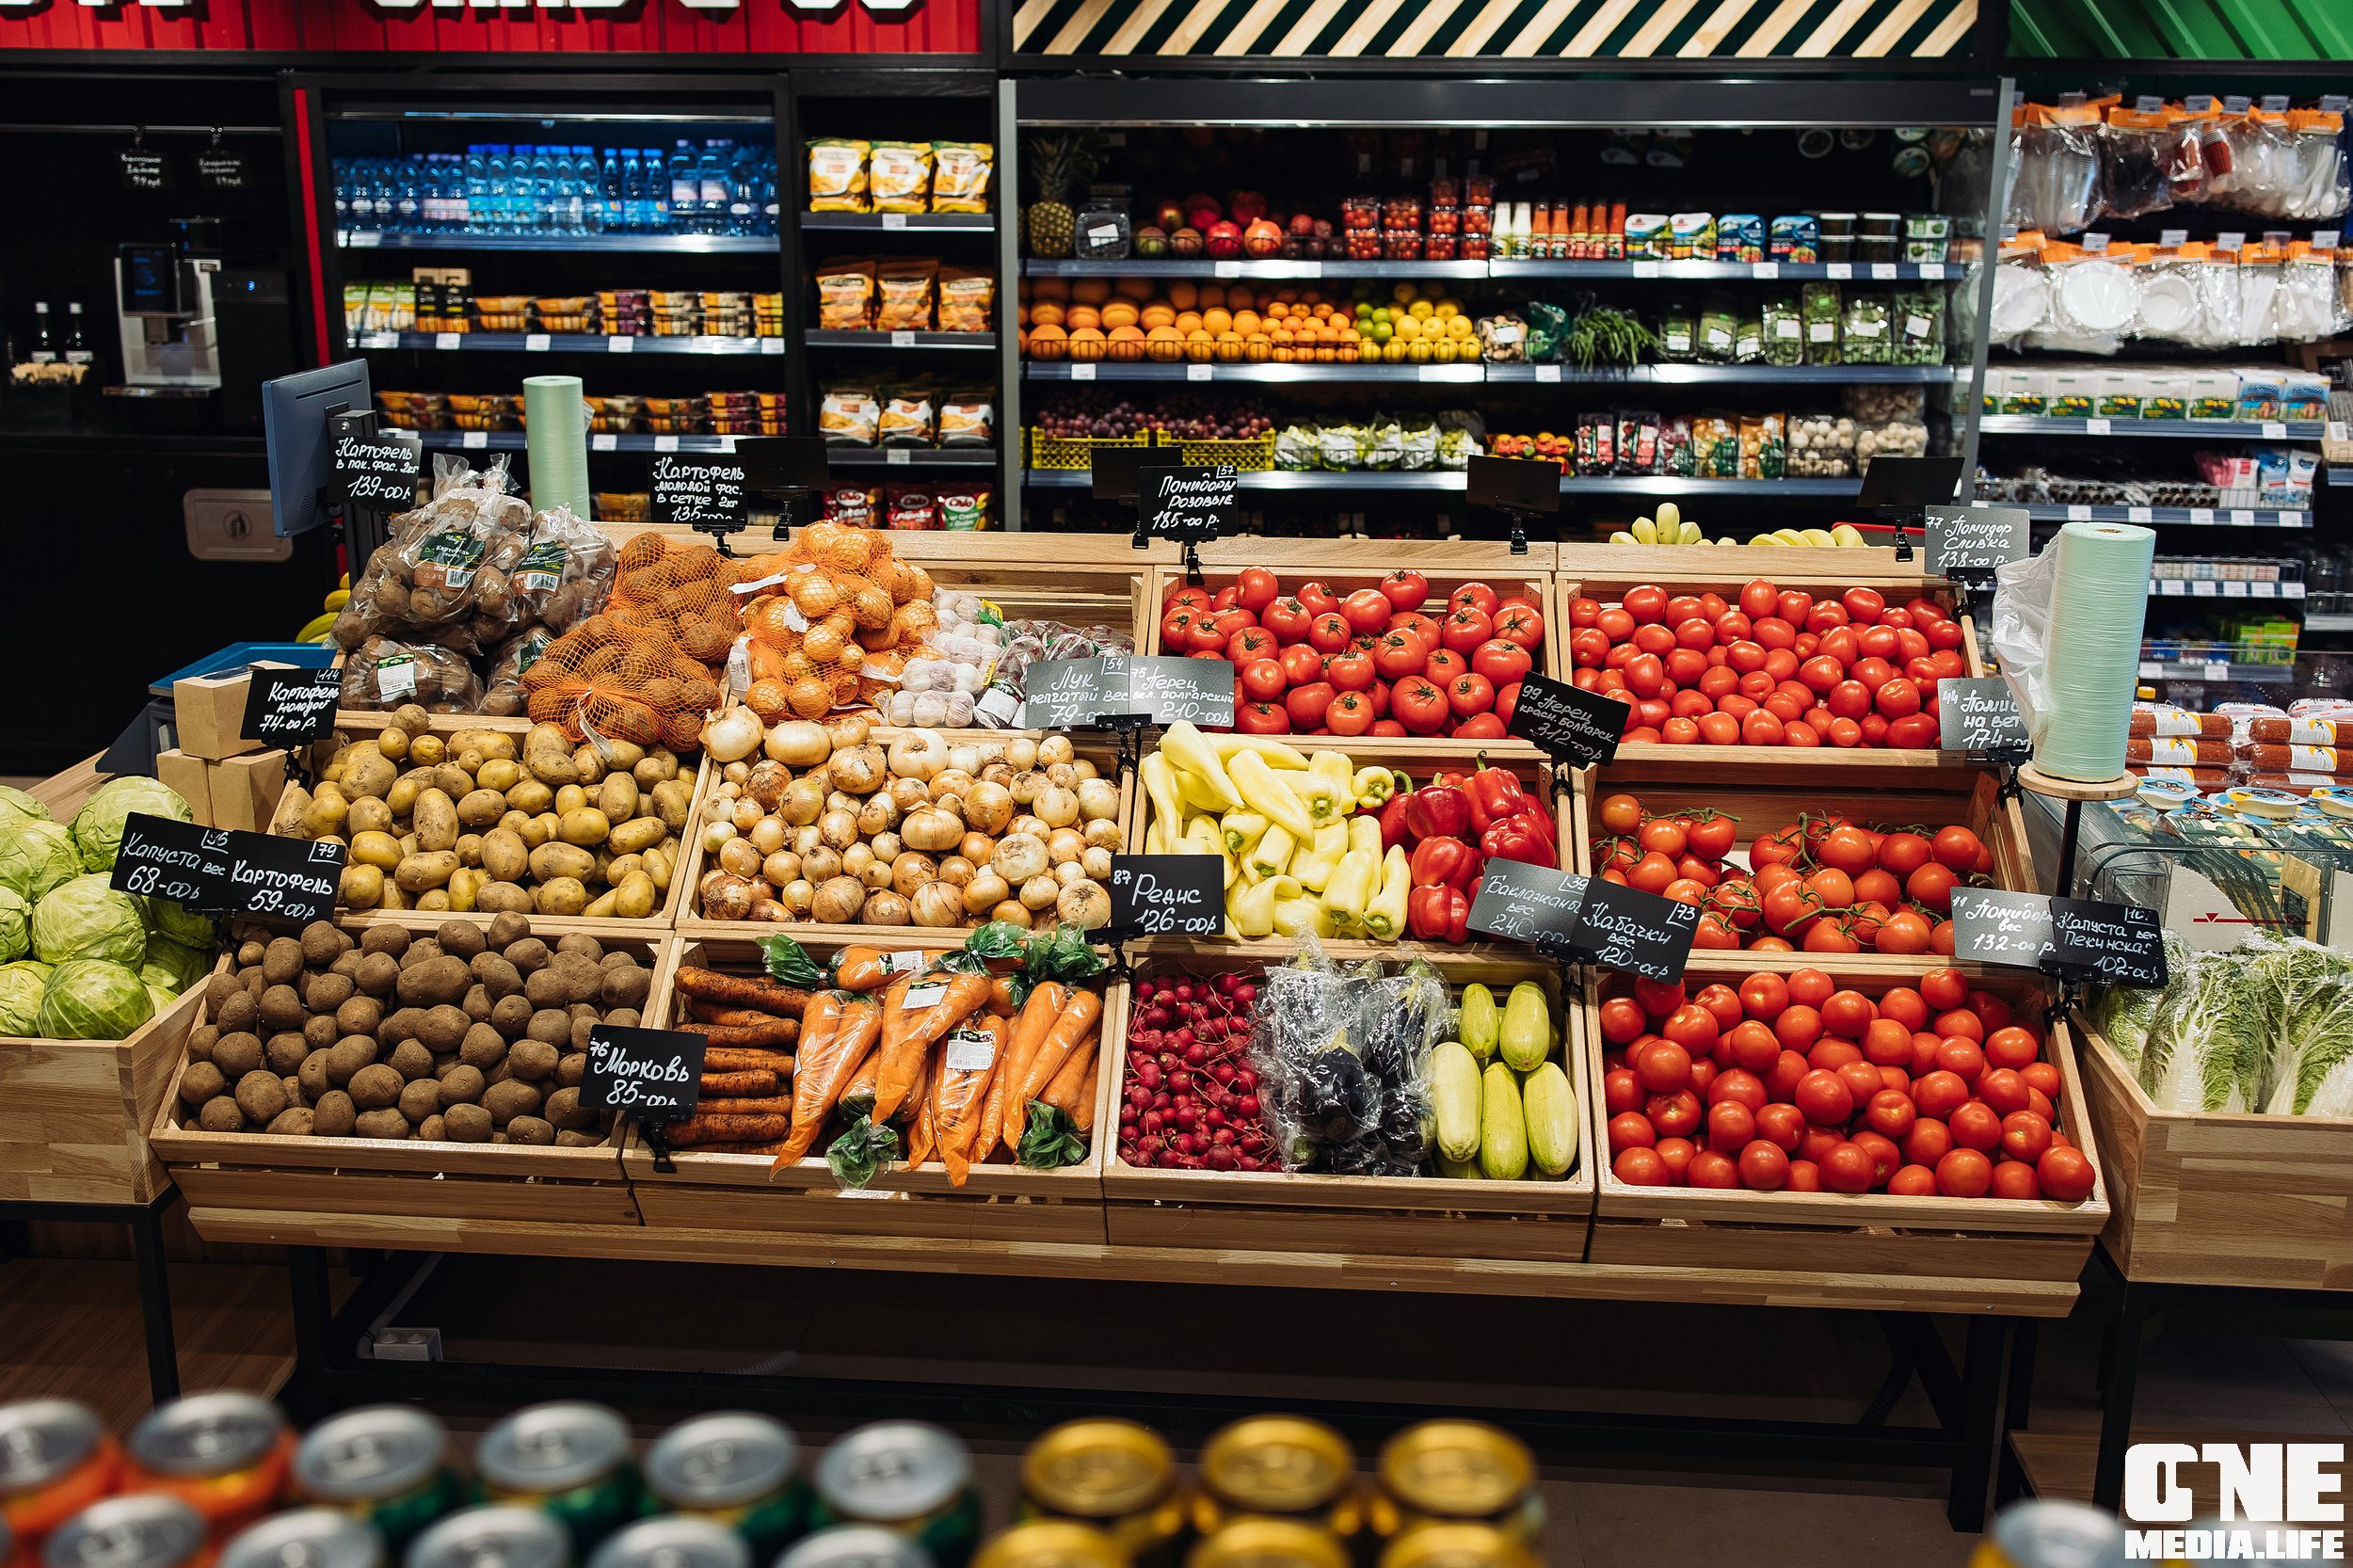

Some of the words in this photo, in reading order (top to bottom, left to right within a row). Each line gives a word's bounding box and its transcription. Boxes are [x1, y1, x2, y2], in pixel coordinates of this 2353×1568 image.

[335, 437, 413, 460] Картофель
[335, 458, 345, 469] в
[347, 459, 371, 471] пак.
[372, 460, 398, 472] фас.
[652, 456, 745, 481] Картофель
[1220, 466, 1235, 475] 57
[654, 480, 711, 493] молодой
[715, 483, 743, 496] фас.
[1158, 472, 1237, 498] Помидоры
[656, 493, 666, 504] в
[670, 494, 712, 505] сетке
[1167, 494, 1234, 510] розовые
[1926, 516, 1945, 529] 77
[1944, 514, 2013, 541] Помидор
[1943, 536, 2011, 551] Сливка
[1106, 657, 1124, 671] 54
[319, 669, 340, 680] 114
[1050, 665, 1095, 691] Лук
[1141, 665, 1198, 693] Перец
[267, 681, 340, 702] Картофель
[1029, 686, 1099, 706] репчатый
[1519, 704, 1557, 723] красн.
[1537, 694, 1593, 725] Перец
[1963, 715, 1987, 728] на
[1991, 715, 2023, 728] вет
[122, 832, 201, 870] Капуста
[201, 862, 226, 876] вес
[318, 843, 338, 858] 79
[231, 859, 333, 895] Картофель
[1112, 869, 1131, 885] 87
[1566, 876, 1590, 891] 39
[1131, 873, 1202, 906] Редис
[1676, 904, 1696, 920] 73
[1582, 902, 1672, 945] Кабачки
[1998, 918, 2023, 933] вес
[2057, 911, 2128, 937] Капуста
[1607, 932, 1636, 950] вес.
[594, 1047, 690, 1082] Морковь
